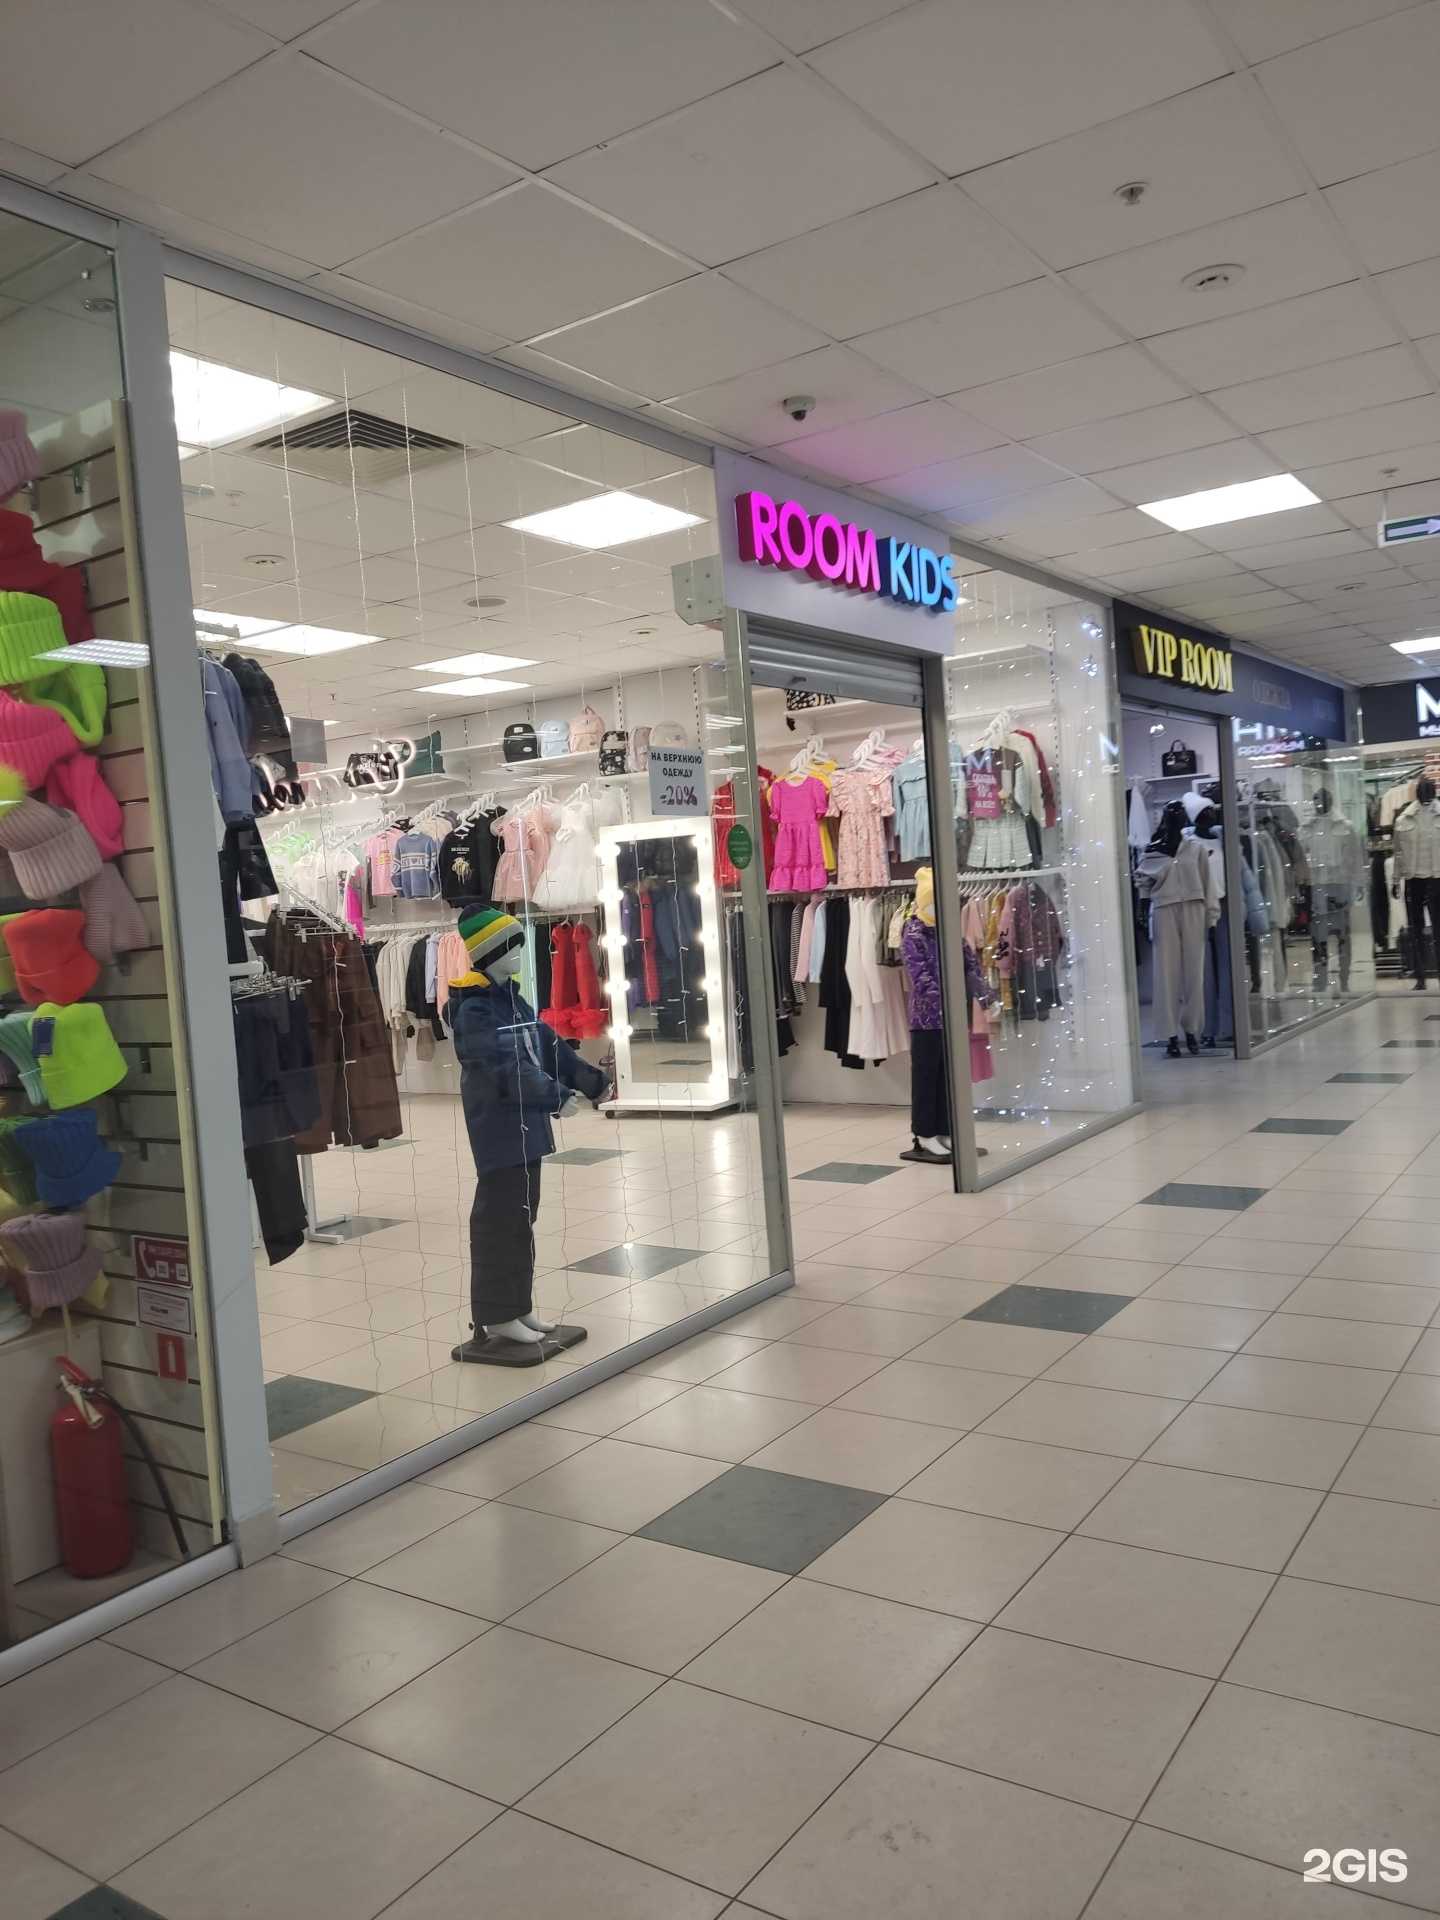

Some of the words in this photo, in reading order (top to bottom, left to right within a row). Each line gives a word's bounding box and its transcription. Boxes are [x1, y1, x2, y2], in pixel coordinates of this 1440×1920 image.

[742, 490, 881, 594] ROOM
[888, 535, 960, 613] KIDS
[1138, 624, 1178, 678] VIP
[1180, 637, 1234, 693] ROOM
[651, 752, 661, 761] НА
[663, 752, 702, 765] ВЕРХНЮЮ
[662, 768, 693, 778] ОДЕЖДУ
[660, 785, 698, 806] -20%
